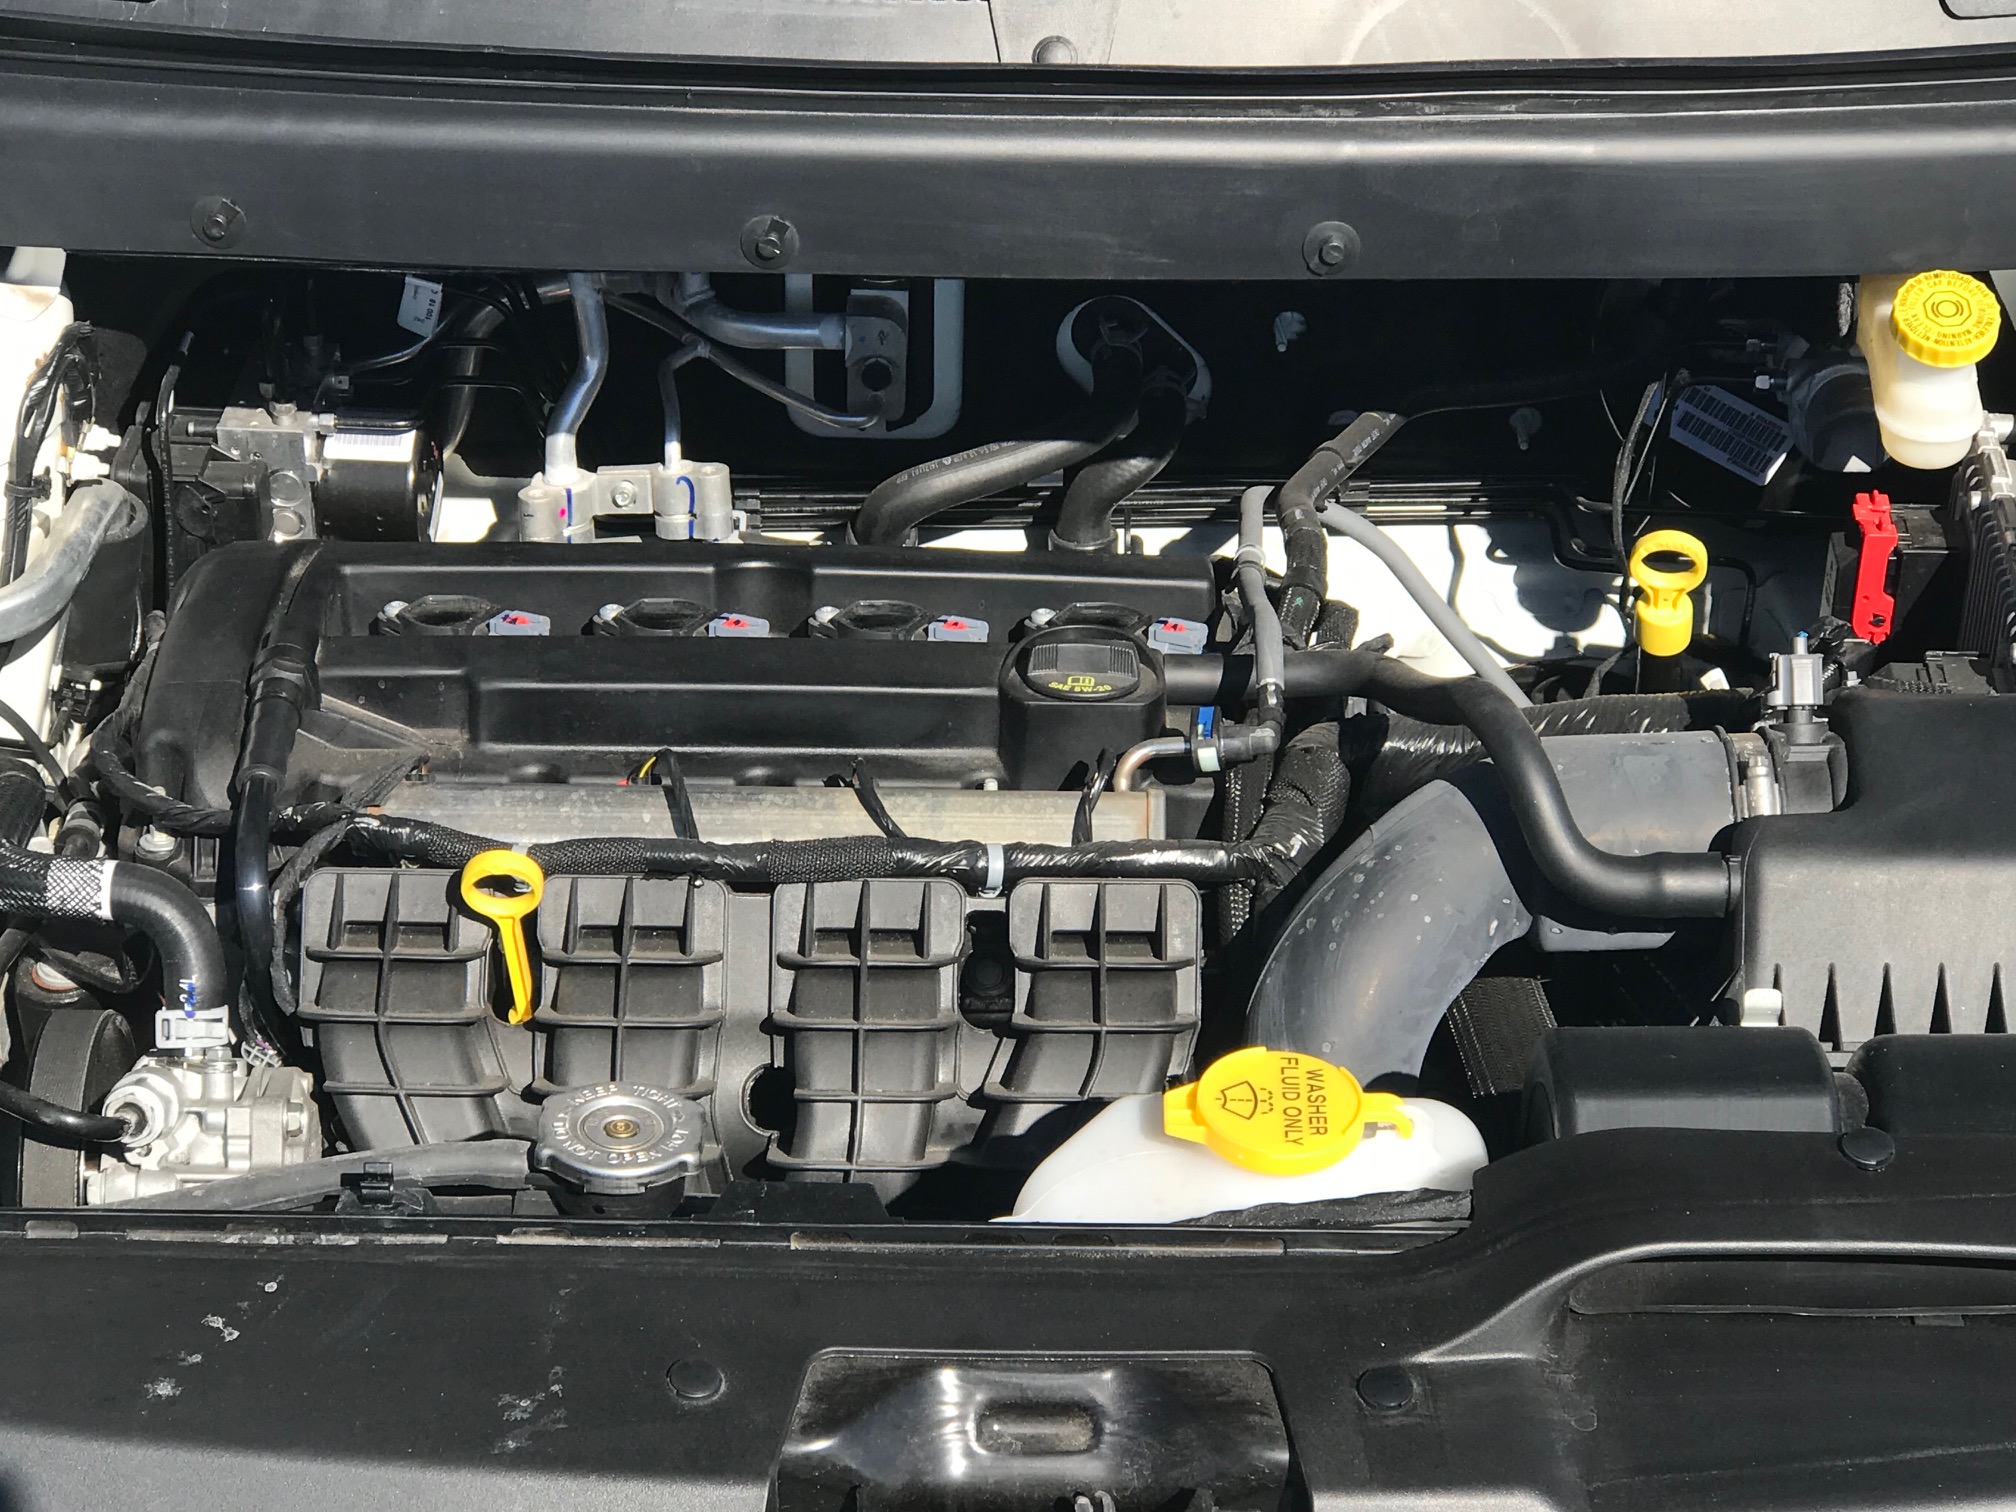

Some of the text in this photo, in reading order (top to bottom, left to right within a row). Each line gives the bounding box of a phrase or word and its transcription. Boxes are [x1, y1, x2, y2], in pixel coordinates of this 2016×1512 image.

[1923, 271, 1974, 285] REMPLISSAGE
[1926, 279, 1943, 289] CAP
[1899, 282, 1917, 307] BOUCHON
[1902, 317, 1931, 342] NETTOYER
[1933, 335, 1972, 346] ATTENTION
[1937, 328, 1972, 339] WARNING
[1048, 681, 1113, 693] SAE 5W-20
[568, 1083, 682, 1108] KEEP TIGHT
[1280, 1056, 1305, 1147] FLUID ONLY
[1306, 1068, 1329, 1136] WASHER
[562, 1139, 601, 1161] NOT
[607, 1150, 663, 1165] OPEN
